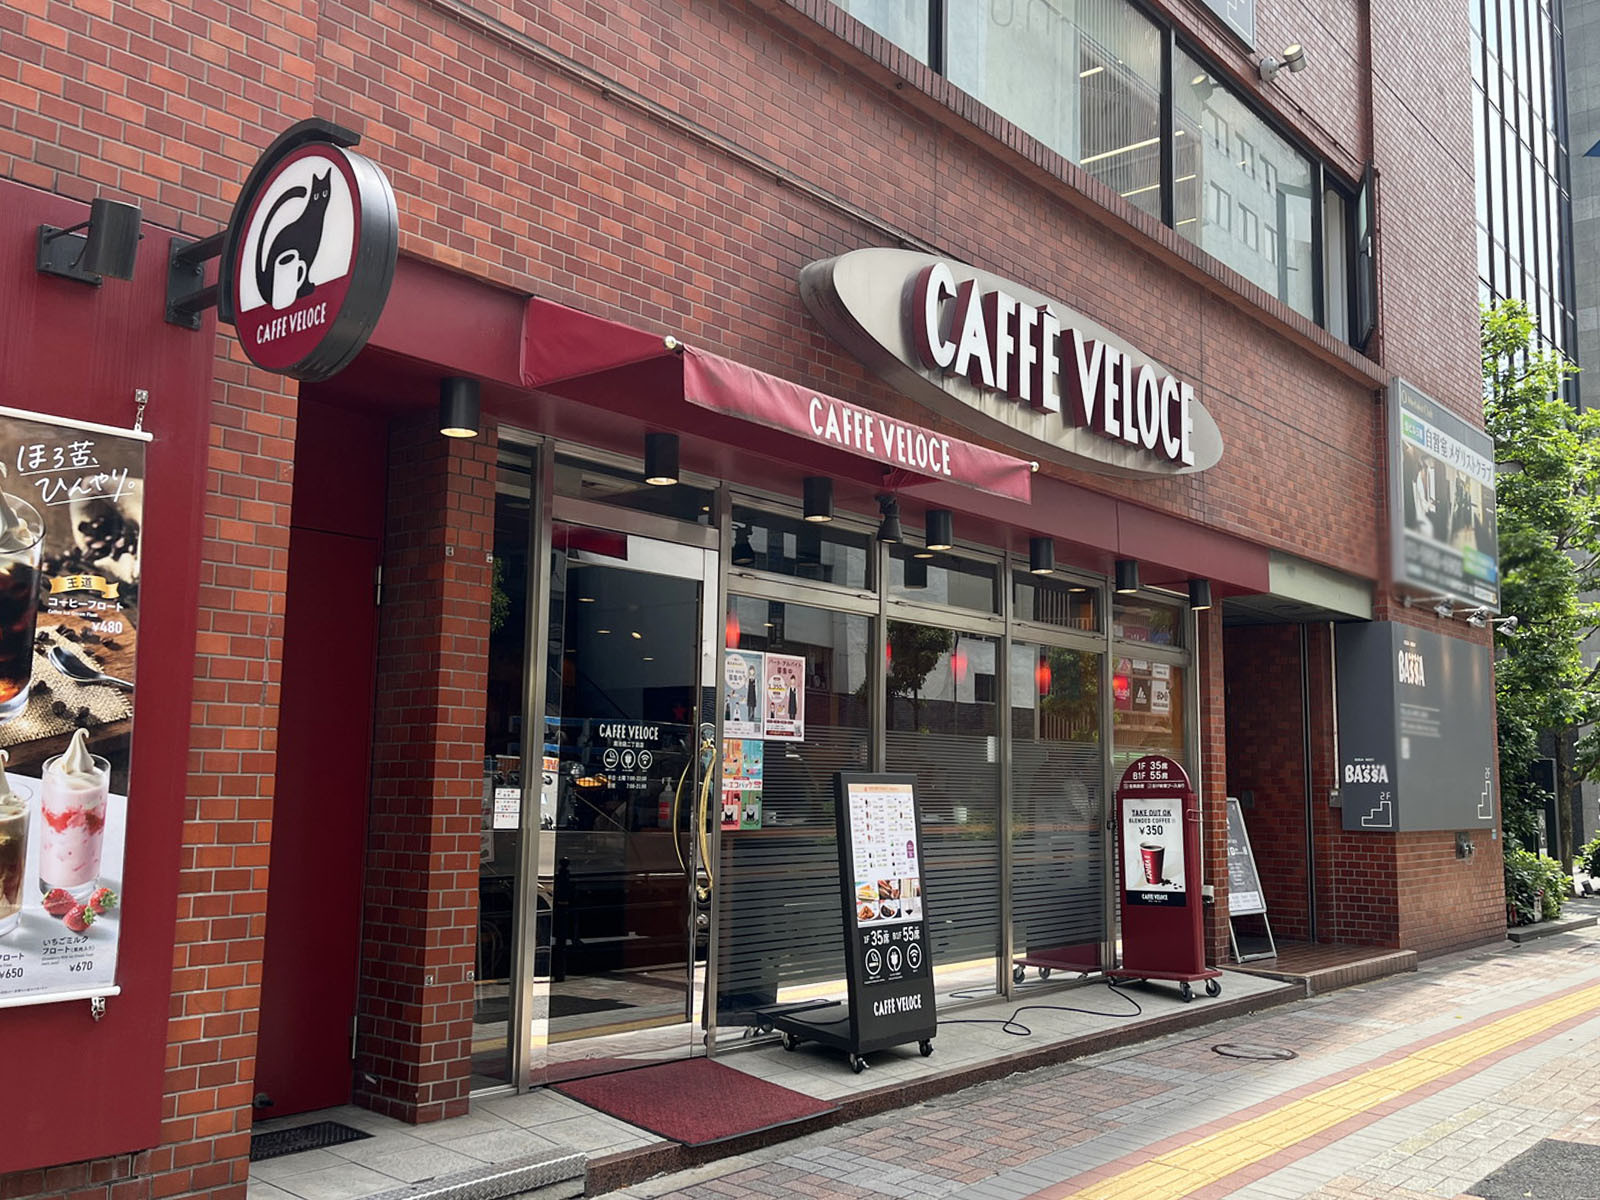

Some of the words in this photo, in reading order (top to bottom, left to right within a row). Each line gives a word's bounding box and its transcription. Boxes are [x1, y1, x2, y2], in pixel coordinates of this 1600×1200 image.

[289, 302, 327, 334] VELOCE
[1071, 328, 1195, 467] VELOCE
[879, 420, 952, 476] VELOCE
[66, 576, 94, 590] 王道
[48, 597, 125, 613] コーヒーフロート
[91, 620, 123, 634] ¥480
[1398, 649, 1426, 687] BASSA
[627, 725, 659, 741] VELOCE
[1138, 761, 1147, 770] 1F
[1132, 771, 1147, 780] B1F
[1344, 764, 1389, 783] BASSA
[1131, 809, 1148, 817] TAKE
[1149, 809, 1161, 817] OUT
[1139, 825, 1163, 836] ¥350
[42, 935, 90, 947] いちごミルク
[69, 960, 93, 973] ¥670
[896, 993, 922, 1012] VELOCE
